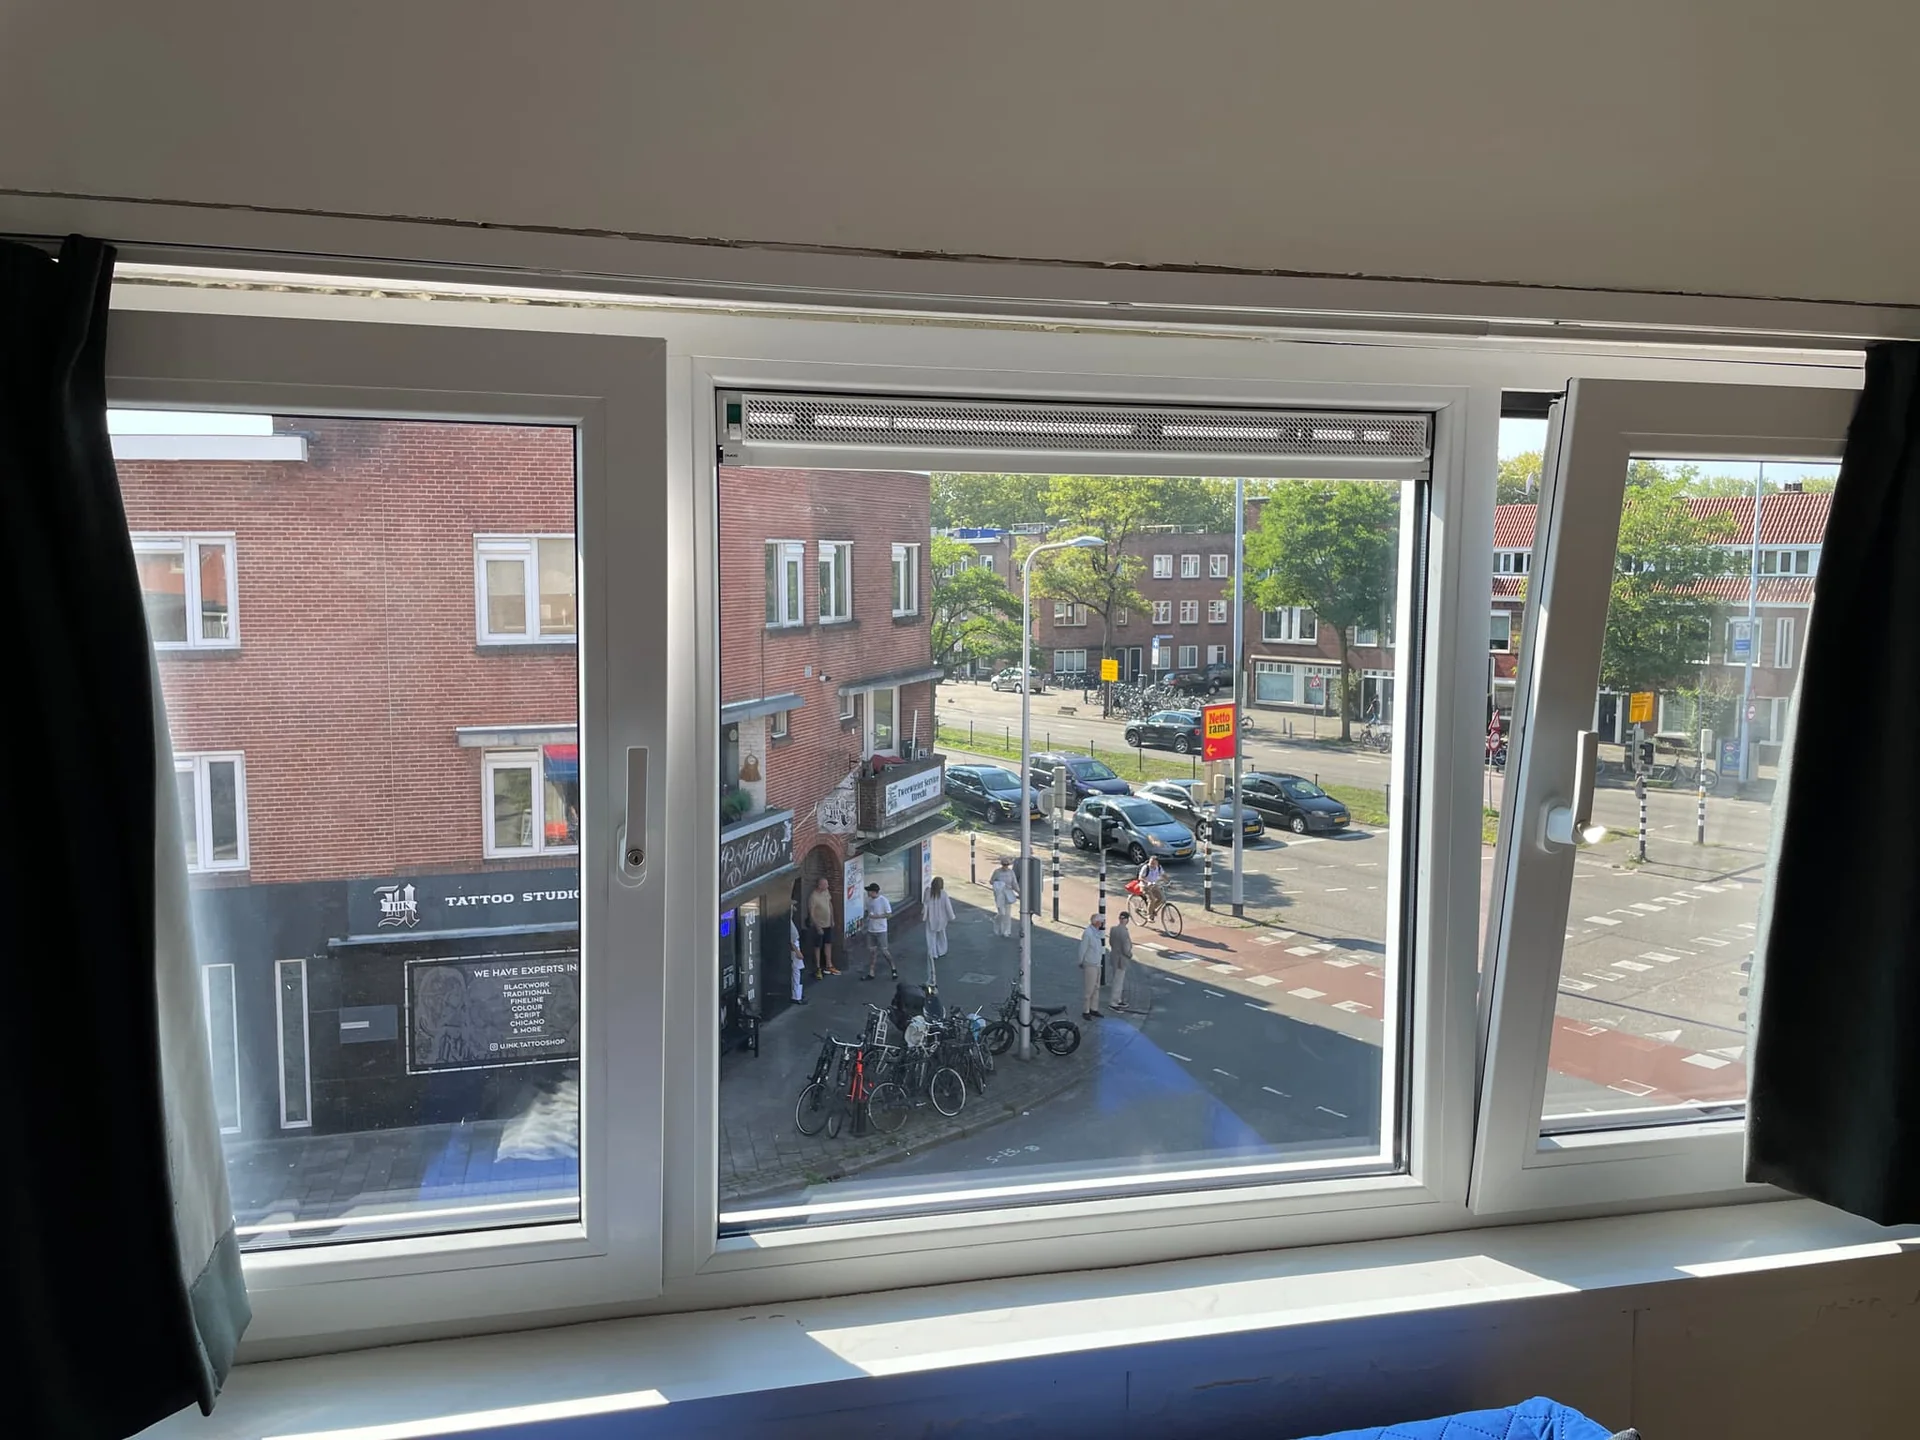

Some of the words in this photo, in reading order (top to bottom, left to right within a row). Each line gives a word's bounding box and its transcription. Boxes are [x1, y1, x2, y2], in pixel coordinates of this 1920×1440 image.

[1208, 712, 1230, 724] Netto
[1209, 723, 1230, 734] rama
[445, 894, 515, 907] TATTOO
[474, 969, 490, 978] WE
[492, 967, 518, 977] HAVE
[521, 964, 564, 975] EXPERTS
[567, 963, 577, 972] IN
[503, 981, 550, 991] BLACKWORK
[502, 988, 552, 998] TRADITIONAL
[510, 996, 544, 1004] FINELINE
[511, 1003, 543, 1012] COLOUR
[514, 1011, 540, 1019] SCRIPT
[510, 1018, 545, 1027] CHICANO
[520, 1026, 542, 1034] MORE
